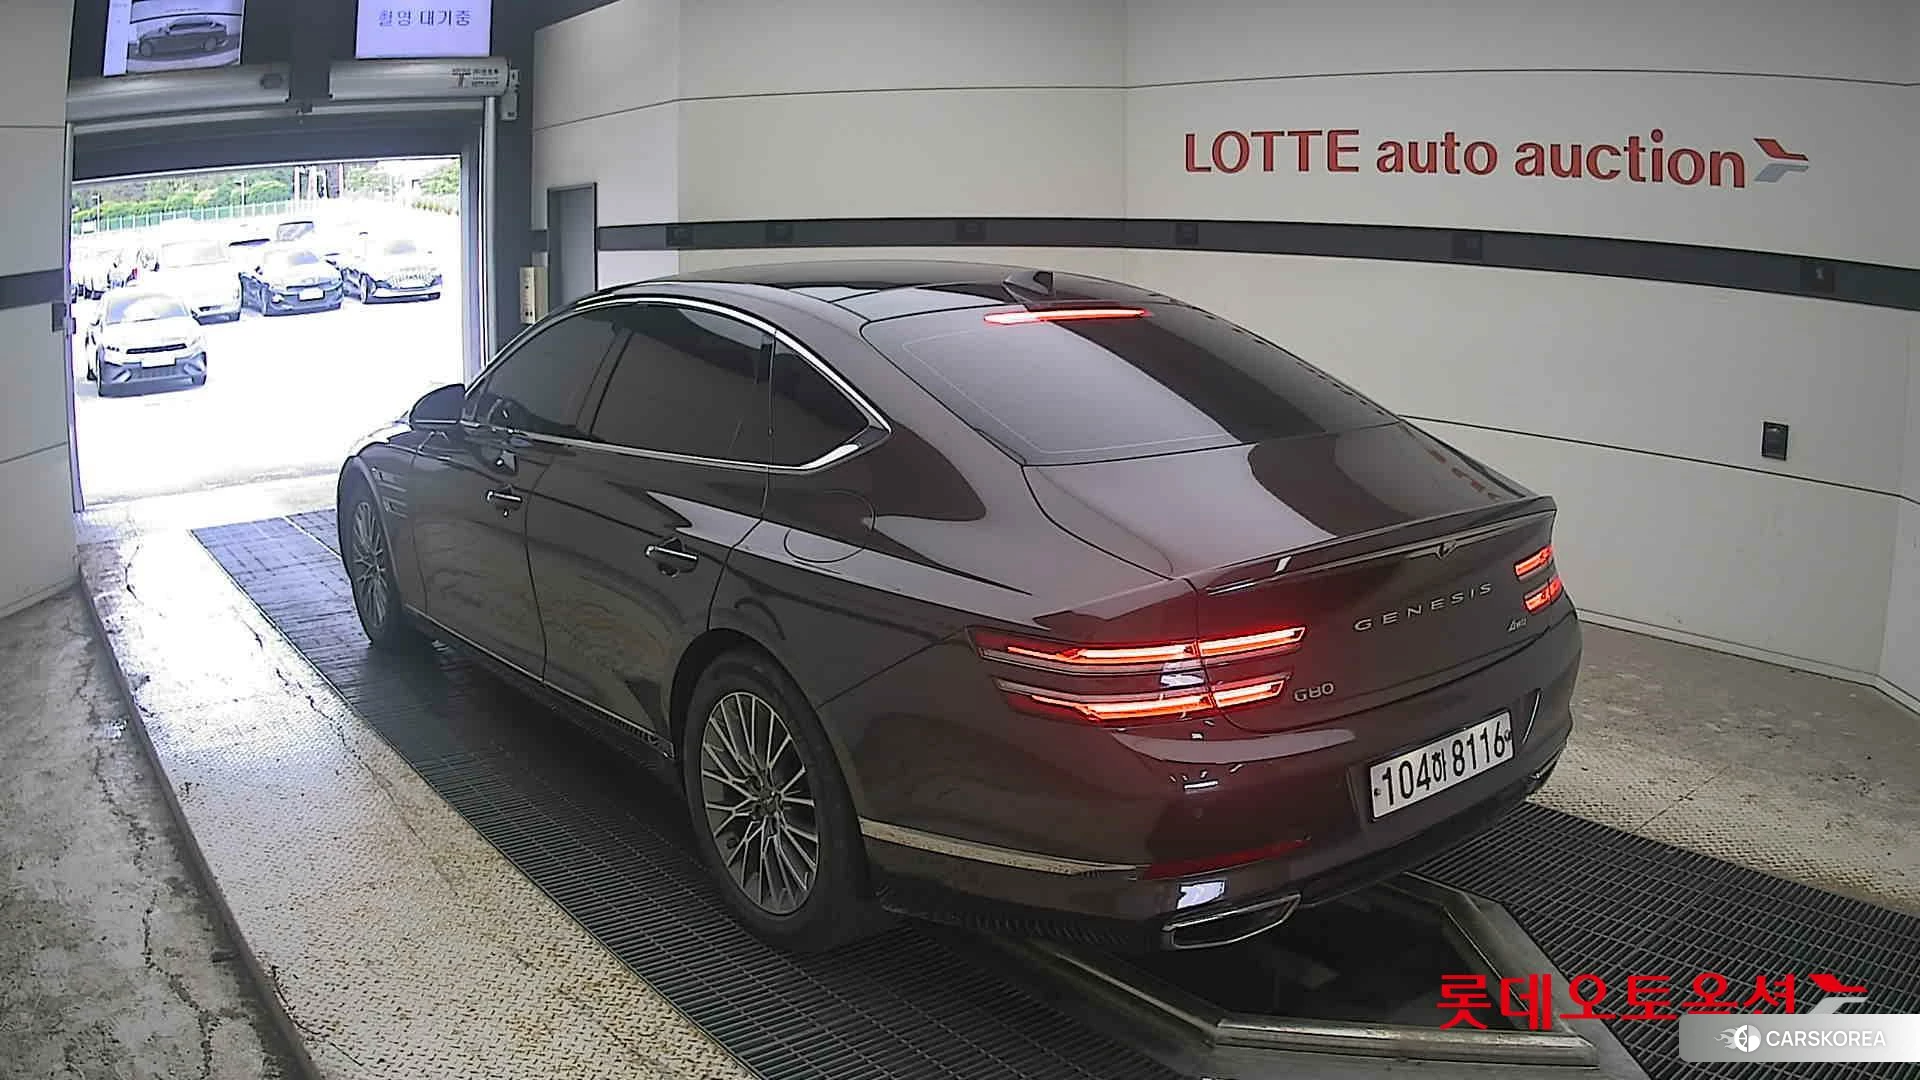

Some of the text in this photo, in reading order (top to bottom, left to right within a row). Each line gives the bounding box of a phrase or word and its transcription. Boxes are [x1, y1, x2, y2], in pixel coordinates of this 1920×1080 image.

[419, 8, 471, 27] 대기중
[1185, 128, 1746, 189] LOTTE auto auction
[1353, 582, 1493, 631] GENESIS
[1294, 682, 1335, 702] G80
[1381, 721, 1506, 806] 104하 8116
